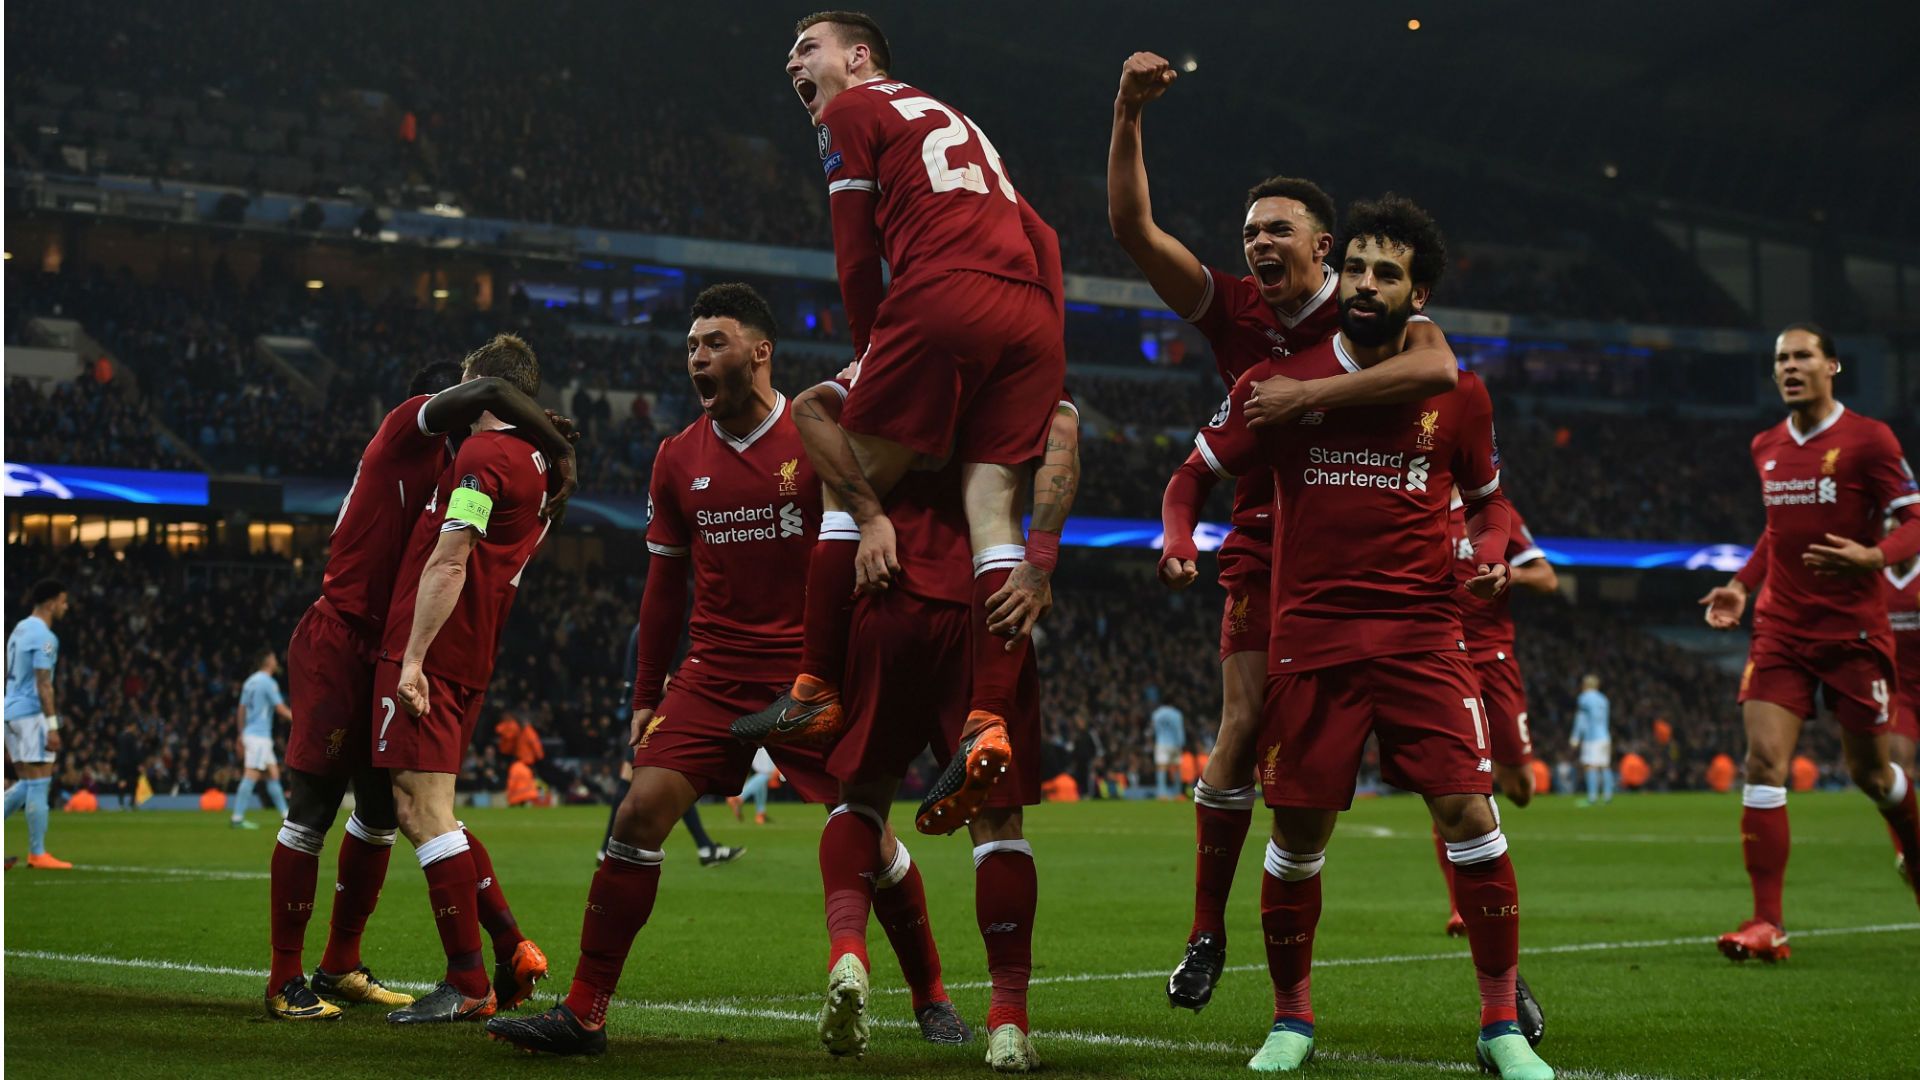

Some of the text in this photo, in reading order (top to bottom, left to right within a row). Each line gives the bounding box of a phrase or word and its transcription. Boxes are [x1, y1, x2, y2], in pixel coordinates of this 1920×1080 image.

[1309, 447, 1403, 469] Standard
[1303, 468, 1401, 490] Chartered
[1764, 478, 1816, 493] Standard
[696, 503, 774, 526] Standard
[379, 696, 396, 740] 7
